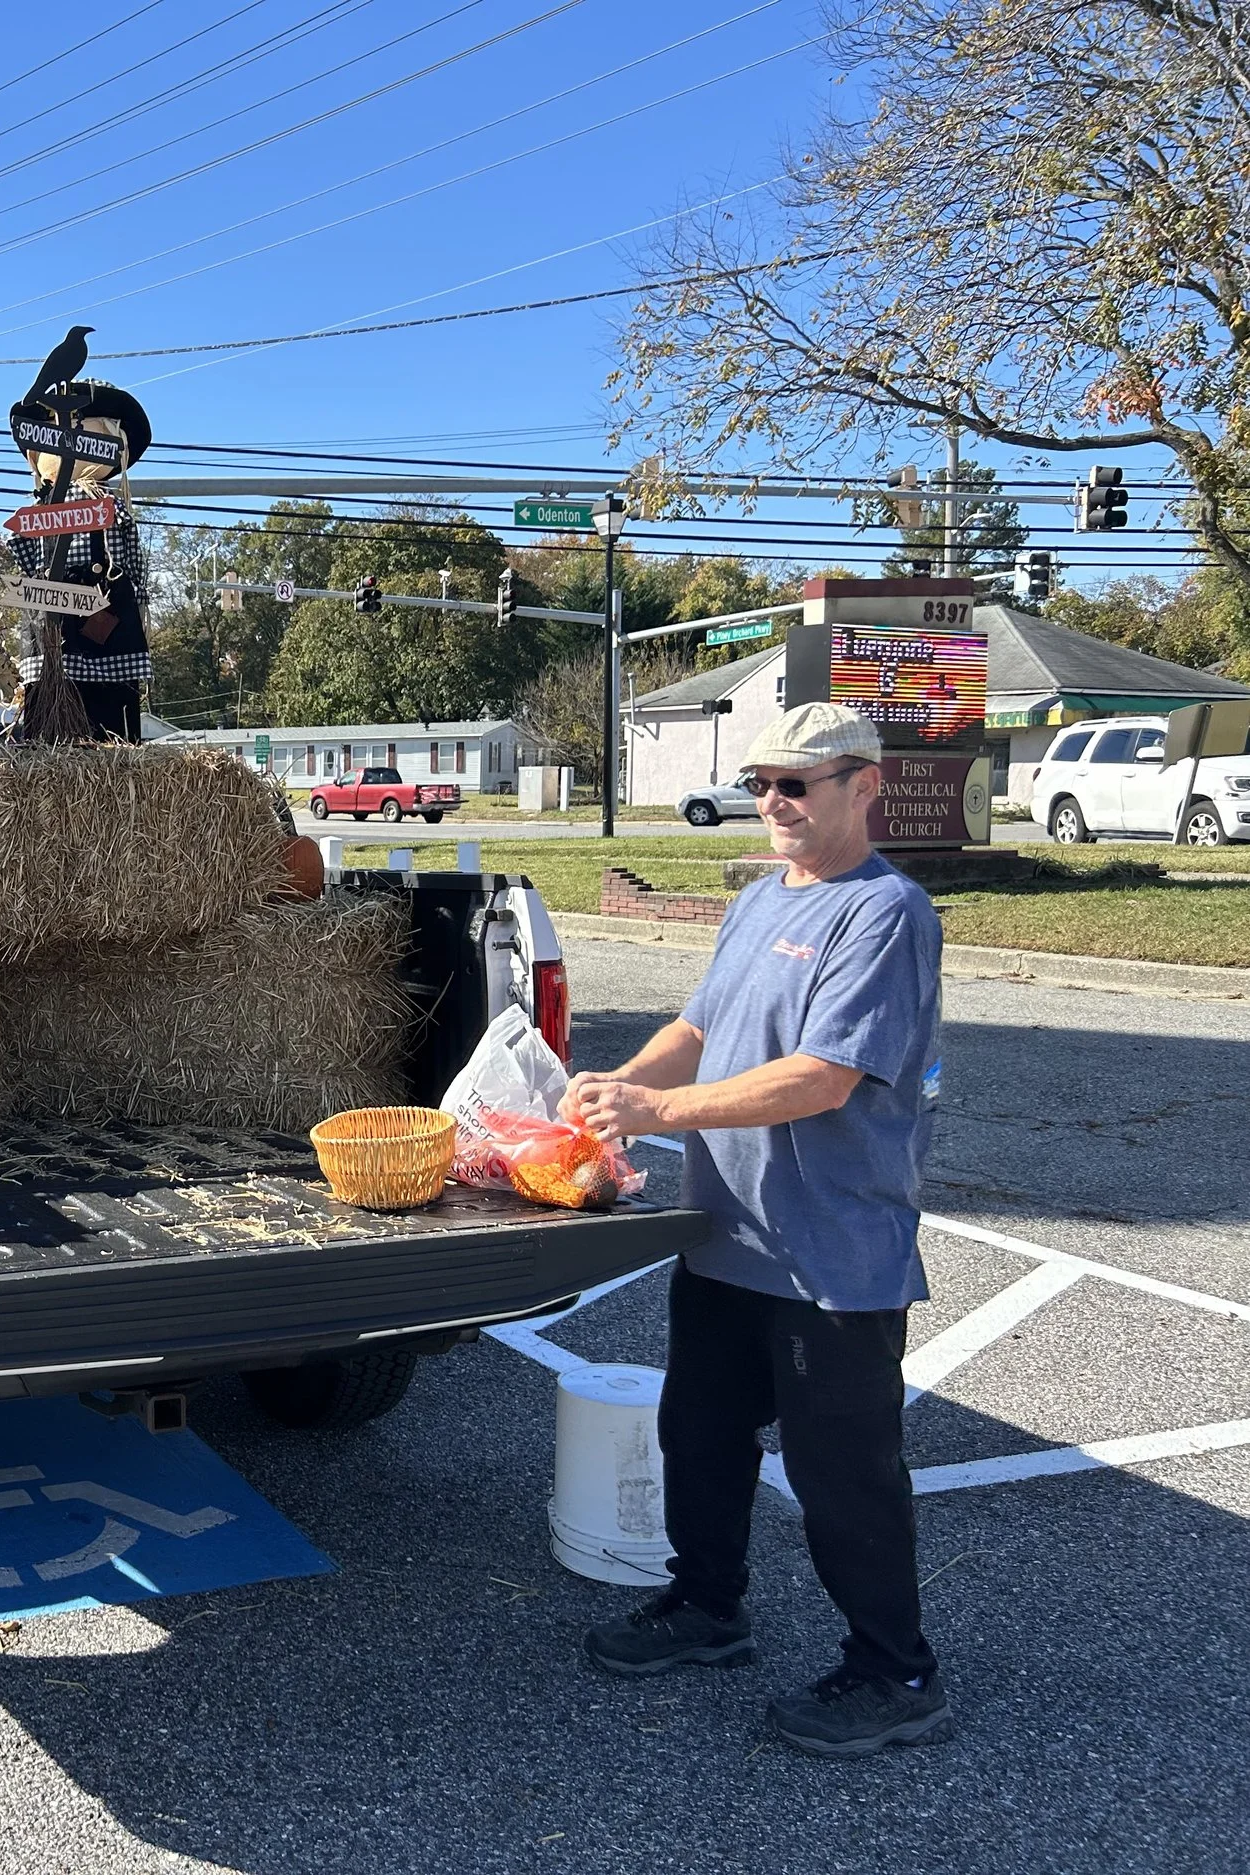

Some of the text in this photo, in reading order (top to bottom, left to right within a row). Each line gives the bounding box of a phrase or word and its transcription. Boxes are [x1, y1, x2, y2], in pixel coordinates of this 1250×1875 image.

[19, 422, 118, 460] SPOOKY STREET
[19, 507, 93, 532] HAUNTED
[538, 507, 580, 522] Odenton
[23, 585, 97, 611] WITCH'S WAY
[923, 601, 969, 624] 8397
[901, 760, 935, 777] FIRST
[877, 780, 957, 797] EVANGELICAL
[884, 800, 949, 816] LUTHERAN
[889, 820, 942, 836] CHURCH
